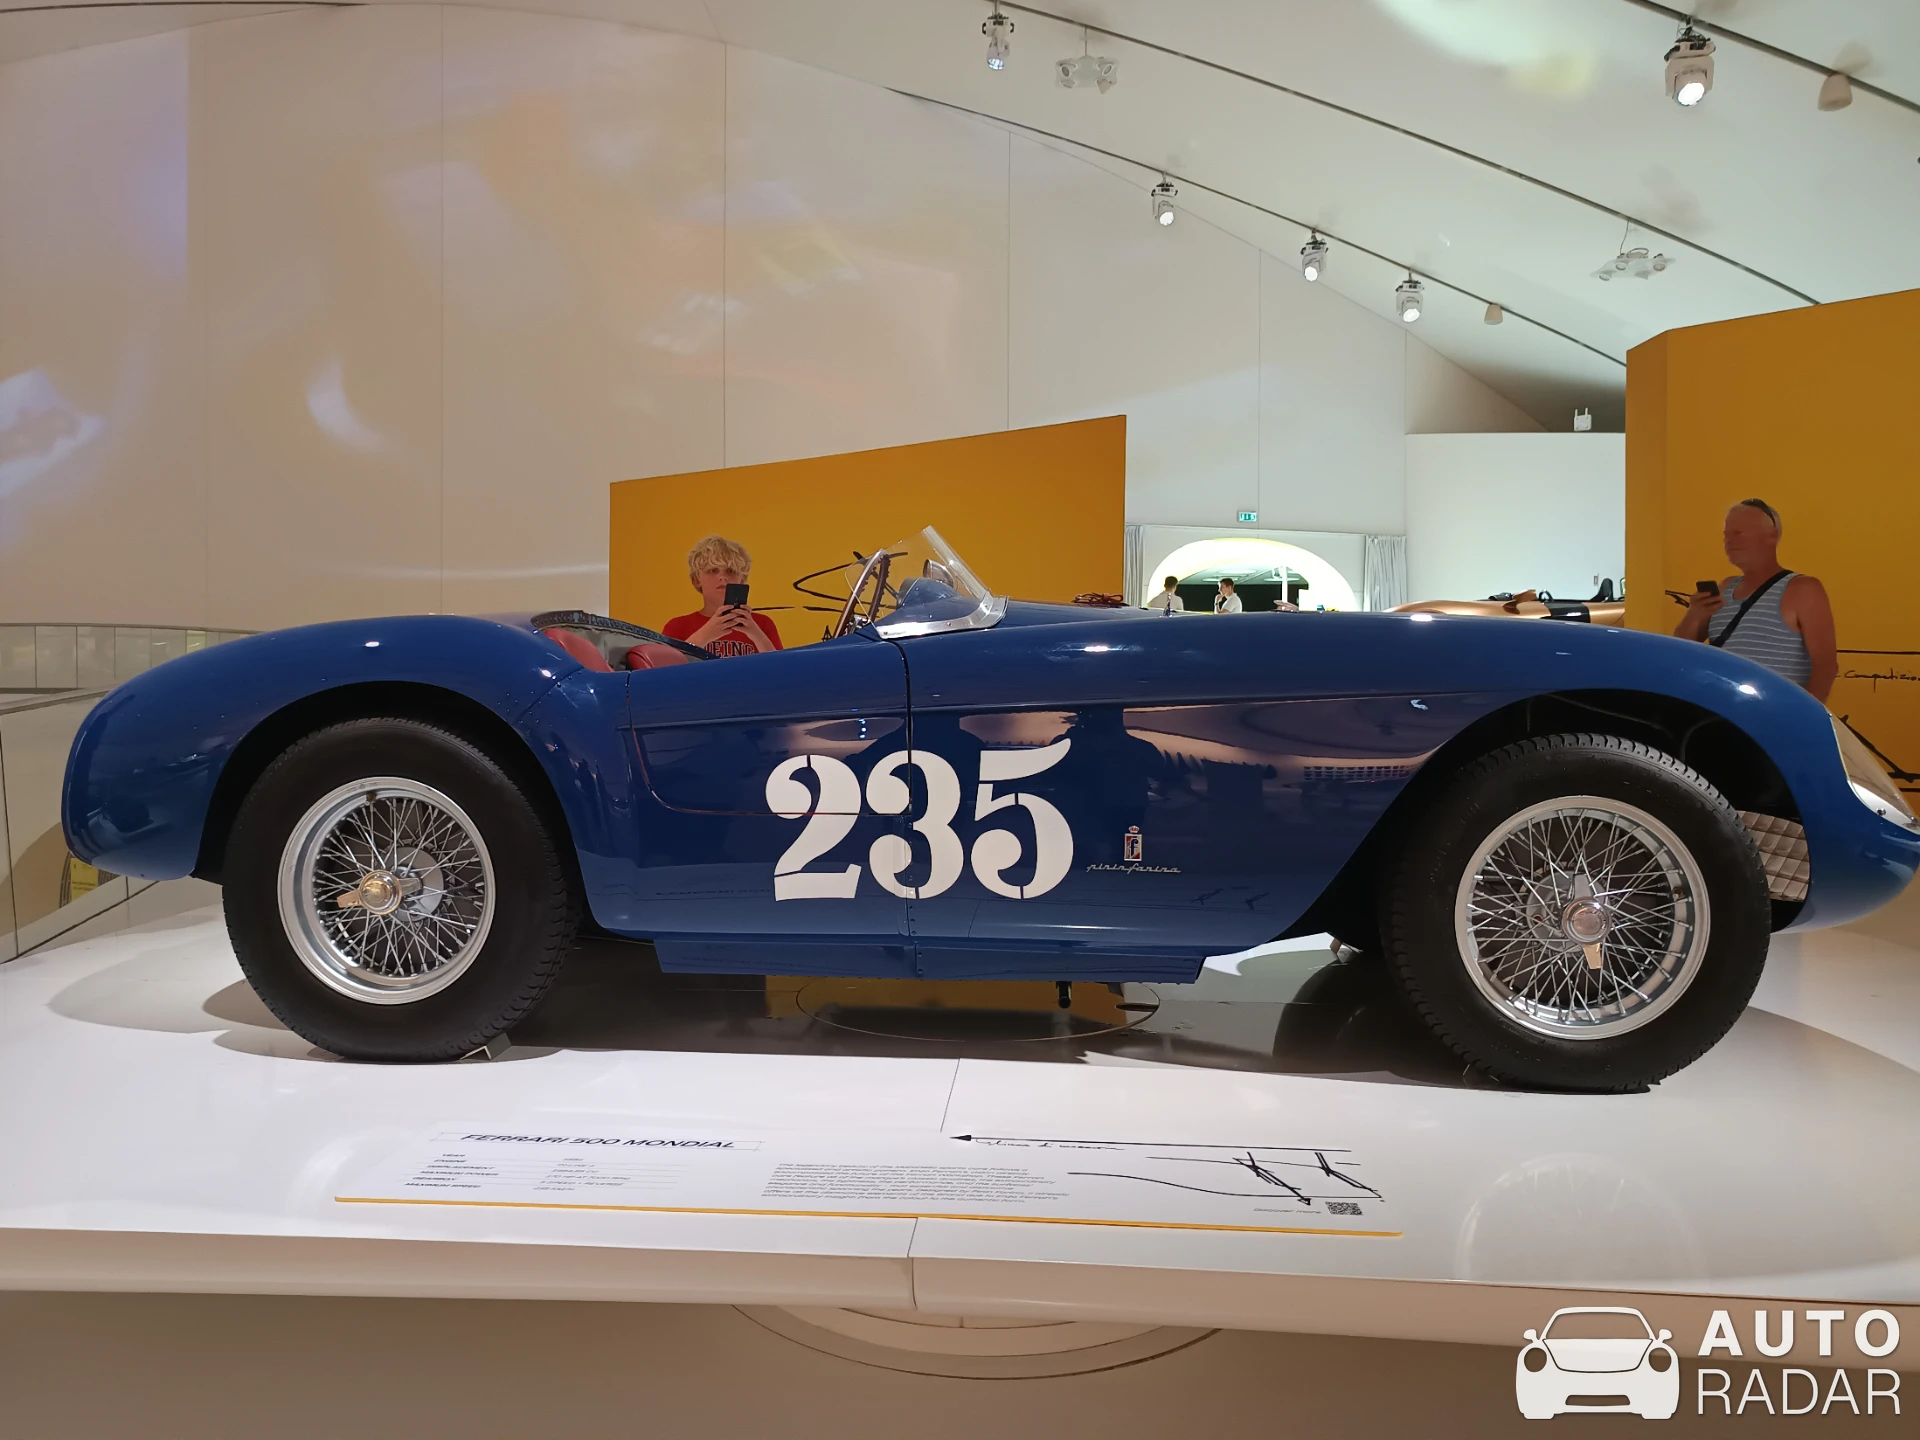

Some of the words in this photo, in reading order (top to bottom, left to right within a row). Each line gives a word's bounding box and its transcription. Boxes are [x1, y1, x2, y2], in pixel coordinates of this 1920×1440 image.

[765, 738, 1073, 901] 235
[1086, 863, 1181, 874] pininfarina
[460, 1134, 569, 1144] FERRARI
[569, 1137, 621, 1145] 500
[622, 1139, 735, 1149] MONDIAL
